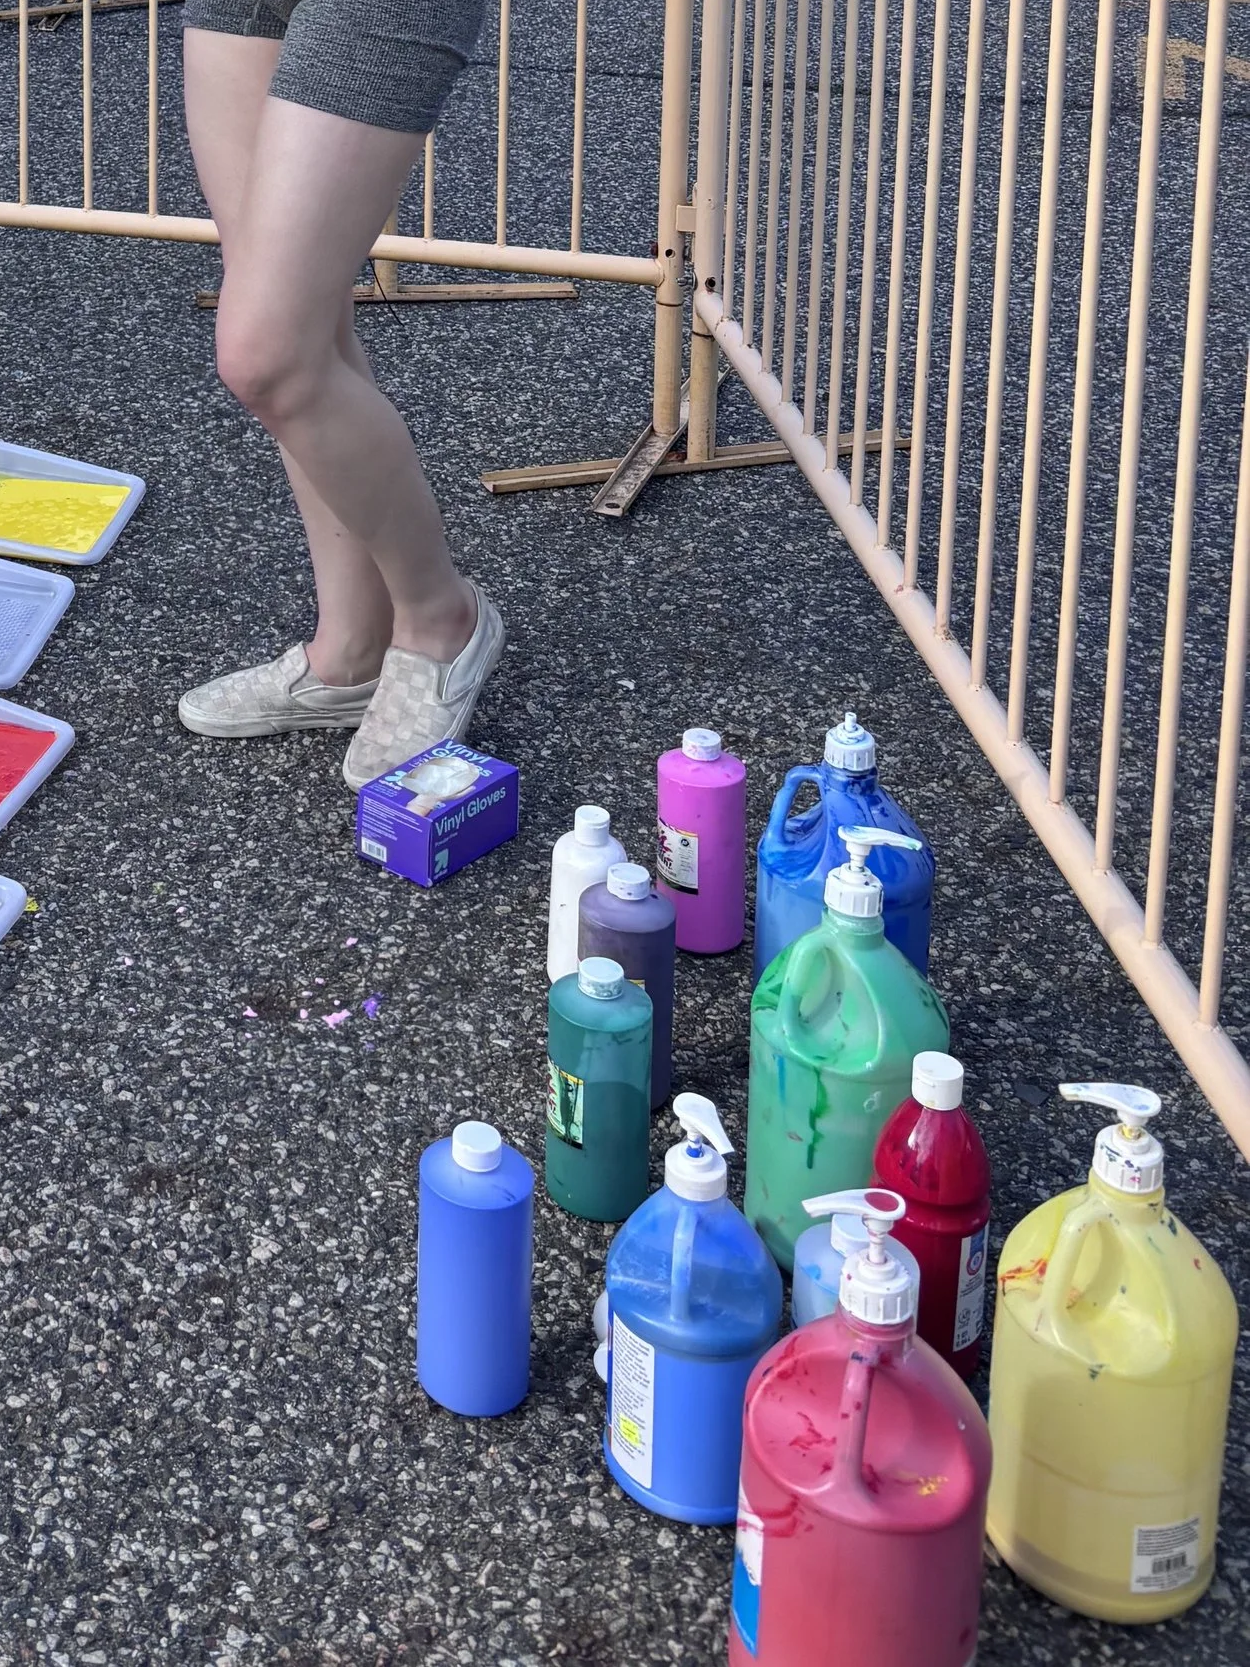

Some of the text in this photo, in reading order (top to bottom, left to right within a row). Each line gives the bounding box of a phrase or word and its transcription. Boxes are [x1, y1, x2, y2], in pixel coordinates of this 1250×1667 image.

[445, 740, 492, 764] Vinyl
[435, 806, 465, 836] Vinyl
[466, 786, 506, 818] Gloves
